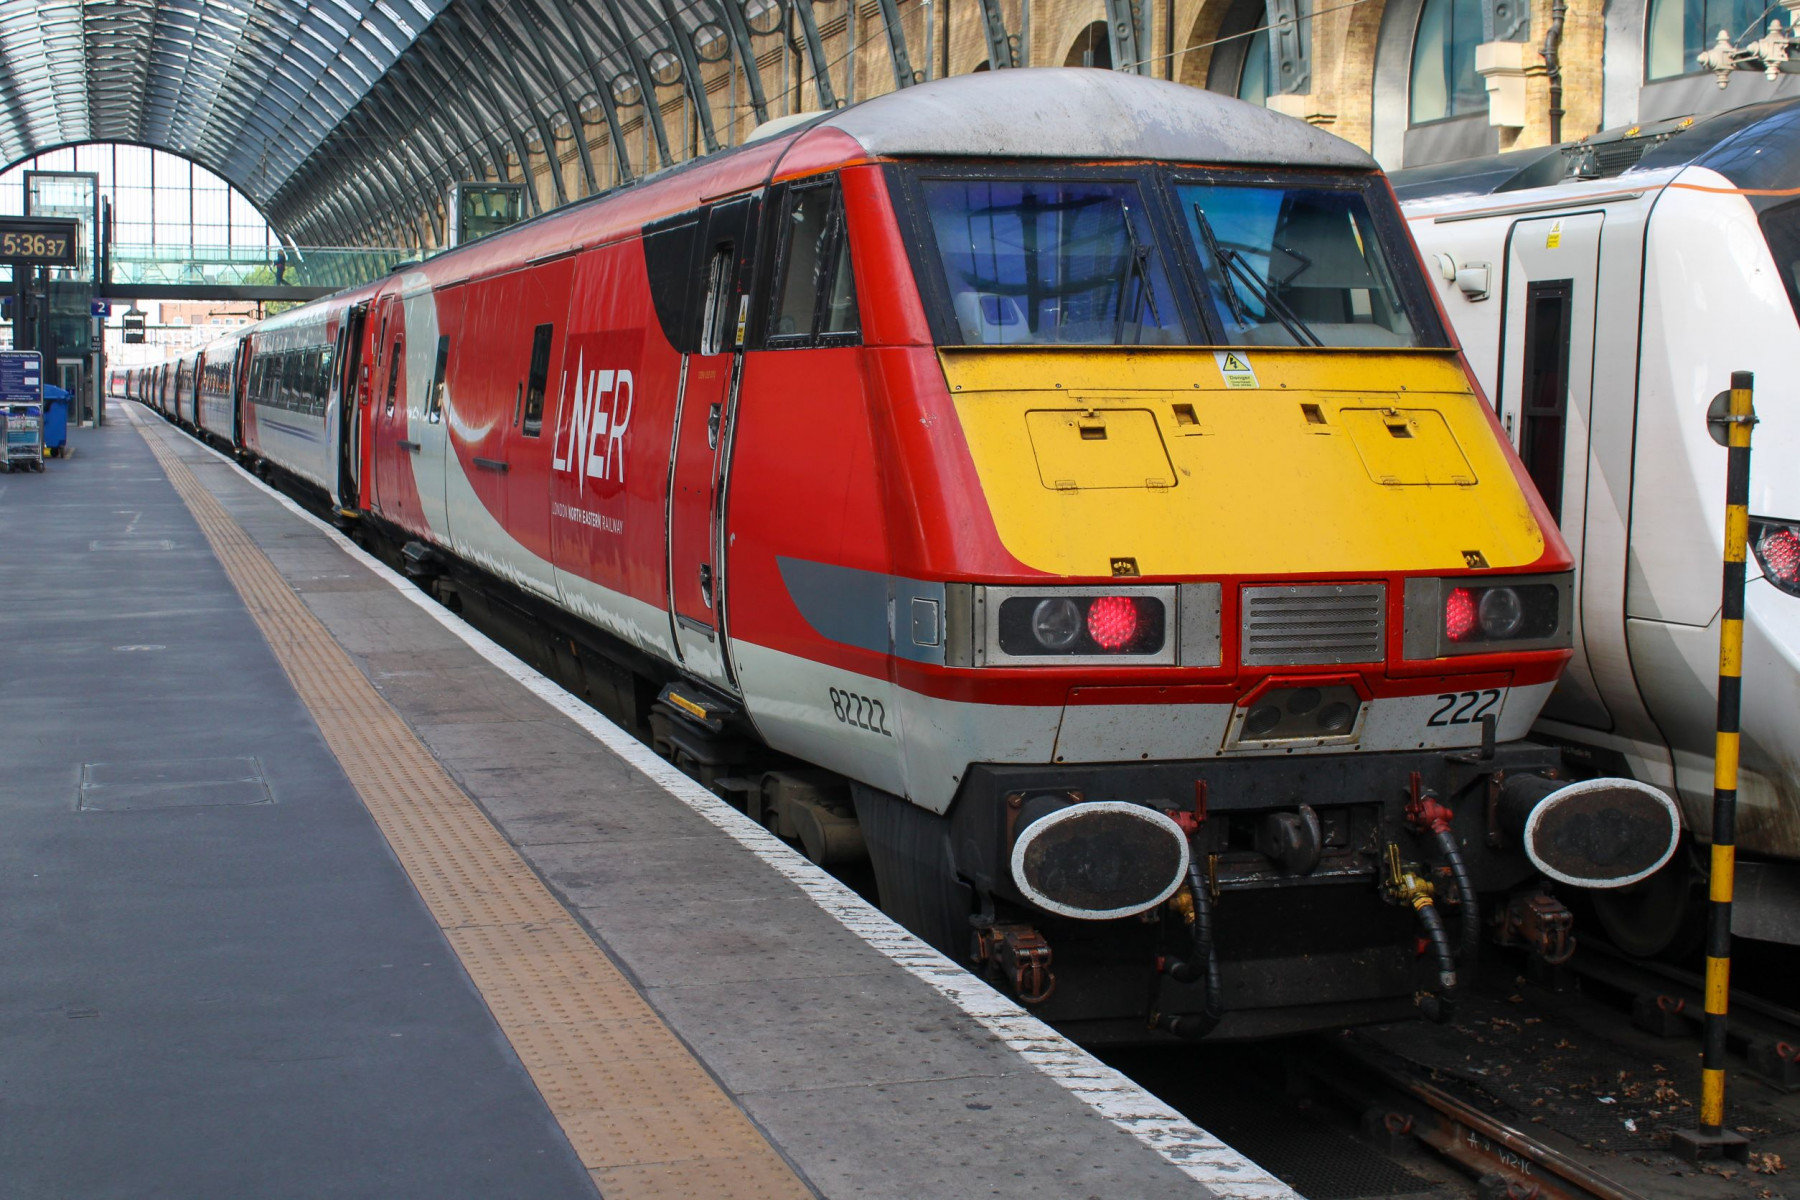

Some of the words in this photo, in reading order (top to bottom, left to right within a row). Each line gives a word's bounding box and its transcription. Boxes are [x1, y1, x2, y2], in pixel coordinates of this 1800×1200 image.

[97, 301, 106, 313] 2
[552, 344, 634, 500] LNER
[568, 504, 582, 523] NORTH
[582, 509, 602, 531] EASTERN
[602, 515, 624, 536] RAILWAY
[829, 686, 892, 737] 82222
[1426, 689, 1500, 727] 222
